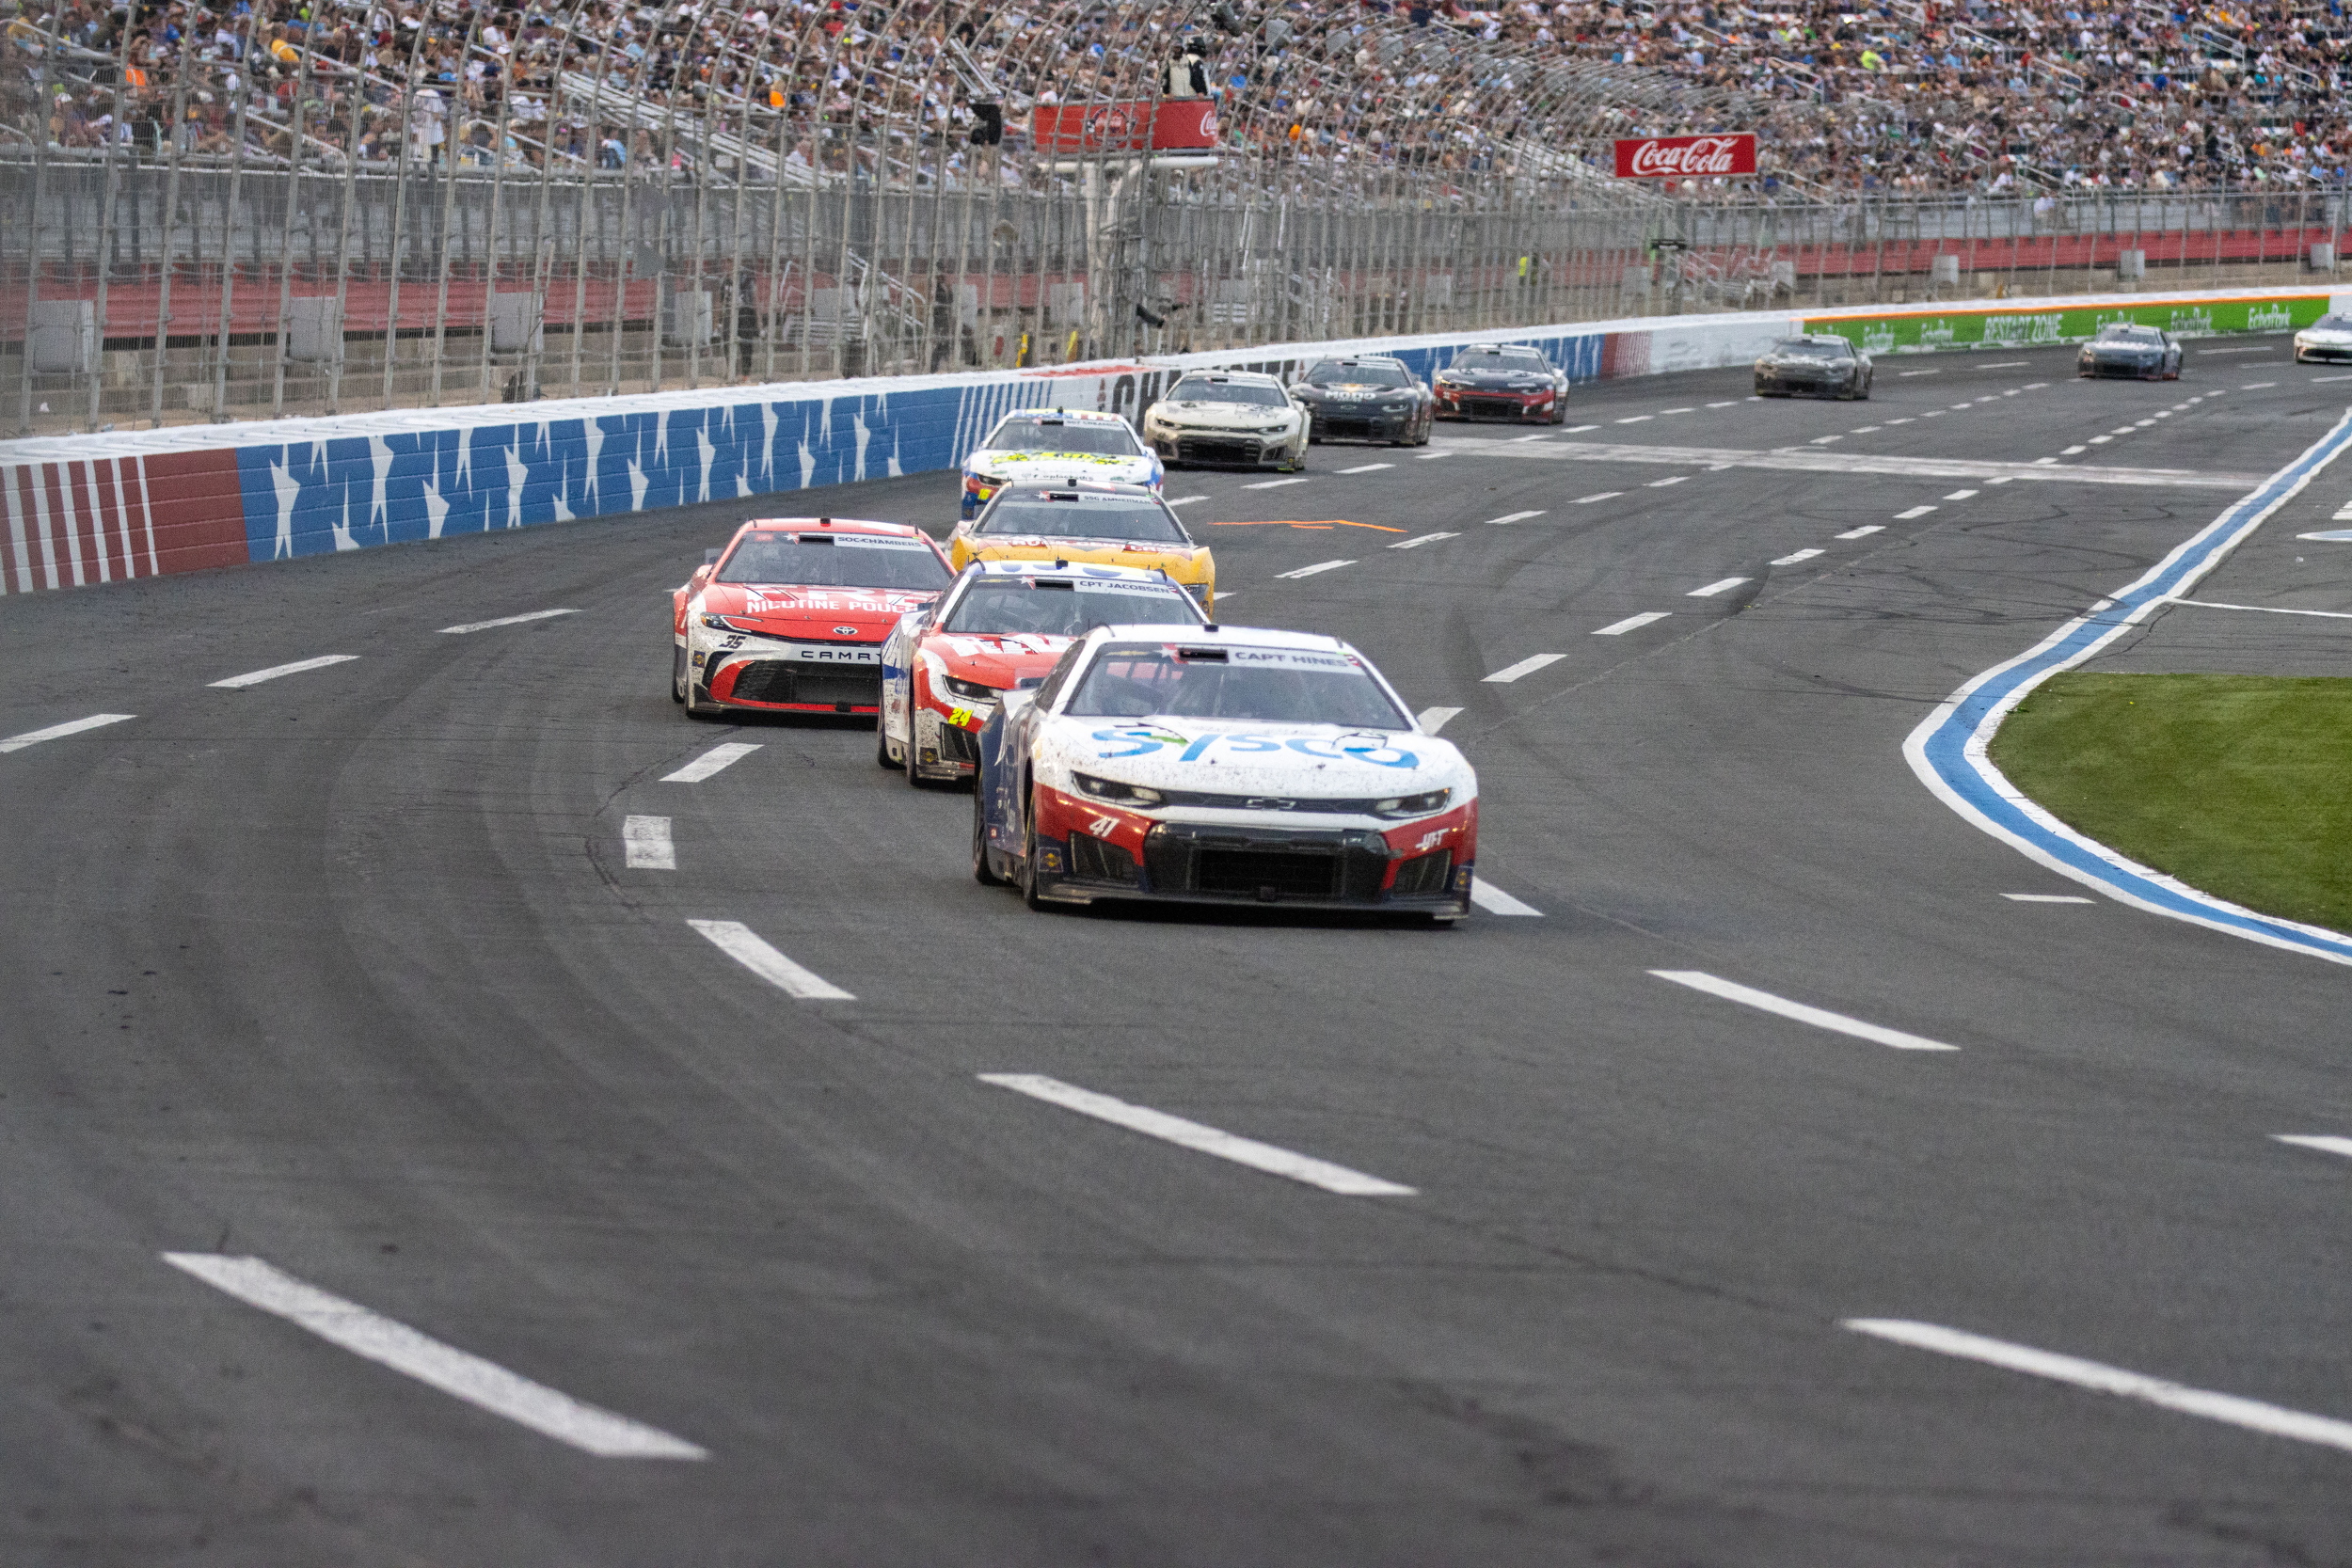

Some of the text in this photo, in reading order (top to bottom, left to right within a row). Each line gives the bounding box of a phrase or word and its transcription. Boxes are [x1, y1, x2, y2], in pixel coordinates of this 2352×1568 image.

[1631, 137, 1740, 176] Coca-Cola
[2248, 303, 2292, 329] EchoPark
[1983, 313, 2063, 341] RESTART ZONE
[1079, 580, 1170, 594] CPT JACOBSEN
[747, 599, 918, 614] NICOTINE POUCH
[719, 635, 746, 649] 35
[1235, 652, 1350, 668] CAPT HINES
[948, 707, 973, 727] 24
[1089, 817, 1120, 837] 41
